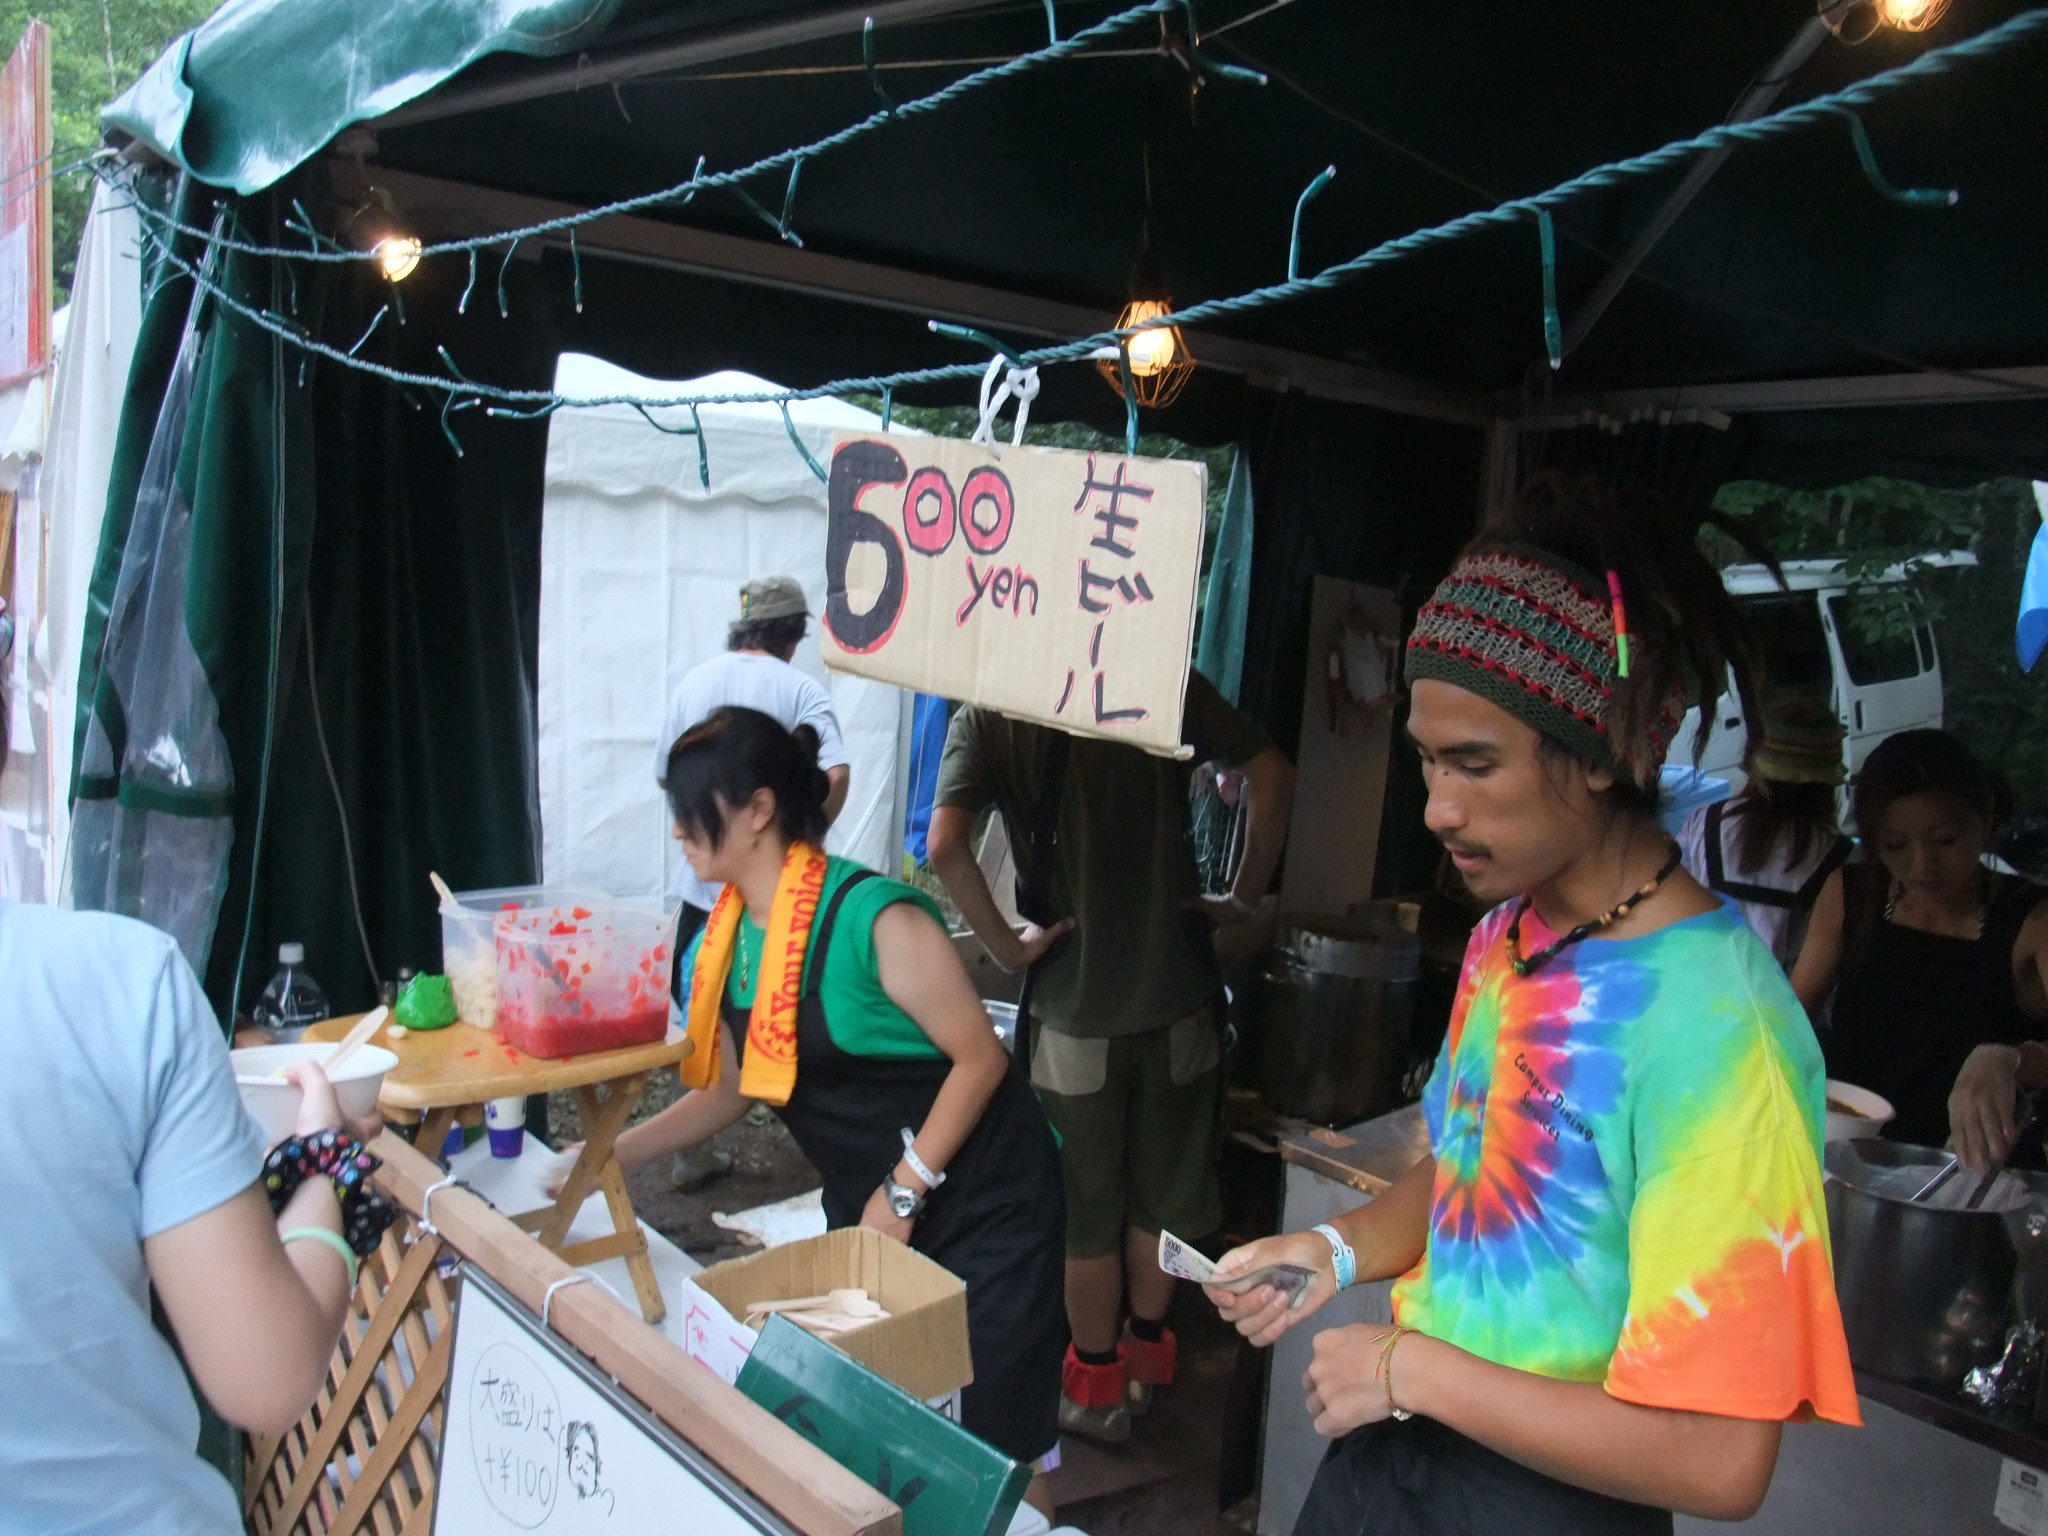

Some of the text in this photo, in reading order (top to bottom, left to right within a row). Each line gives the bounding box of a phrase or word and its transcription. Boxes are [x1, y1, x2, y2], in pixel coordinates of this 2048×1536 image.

[822, 440, 1015, 654] 600
[956, 556, 1039, 627] yen
[1054, 451, 1155, 725] 生ビール
[1514, 1052, 1594, 1142] Campus Dining
